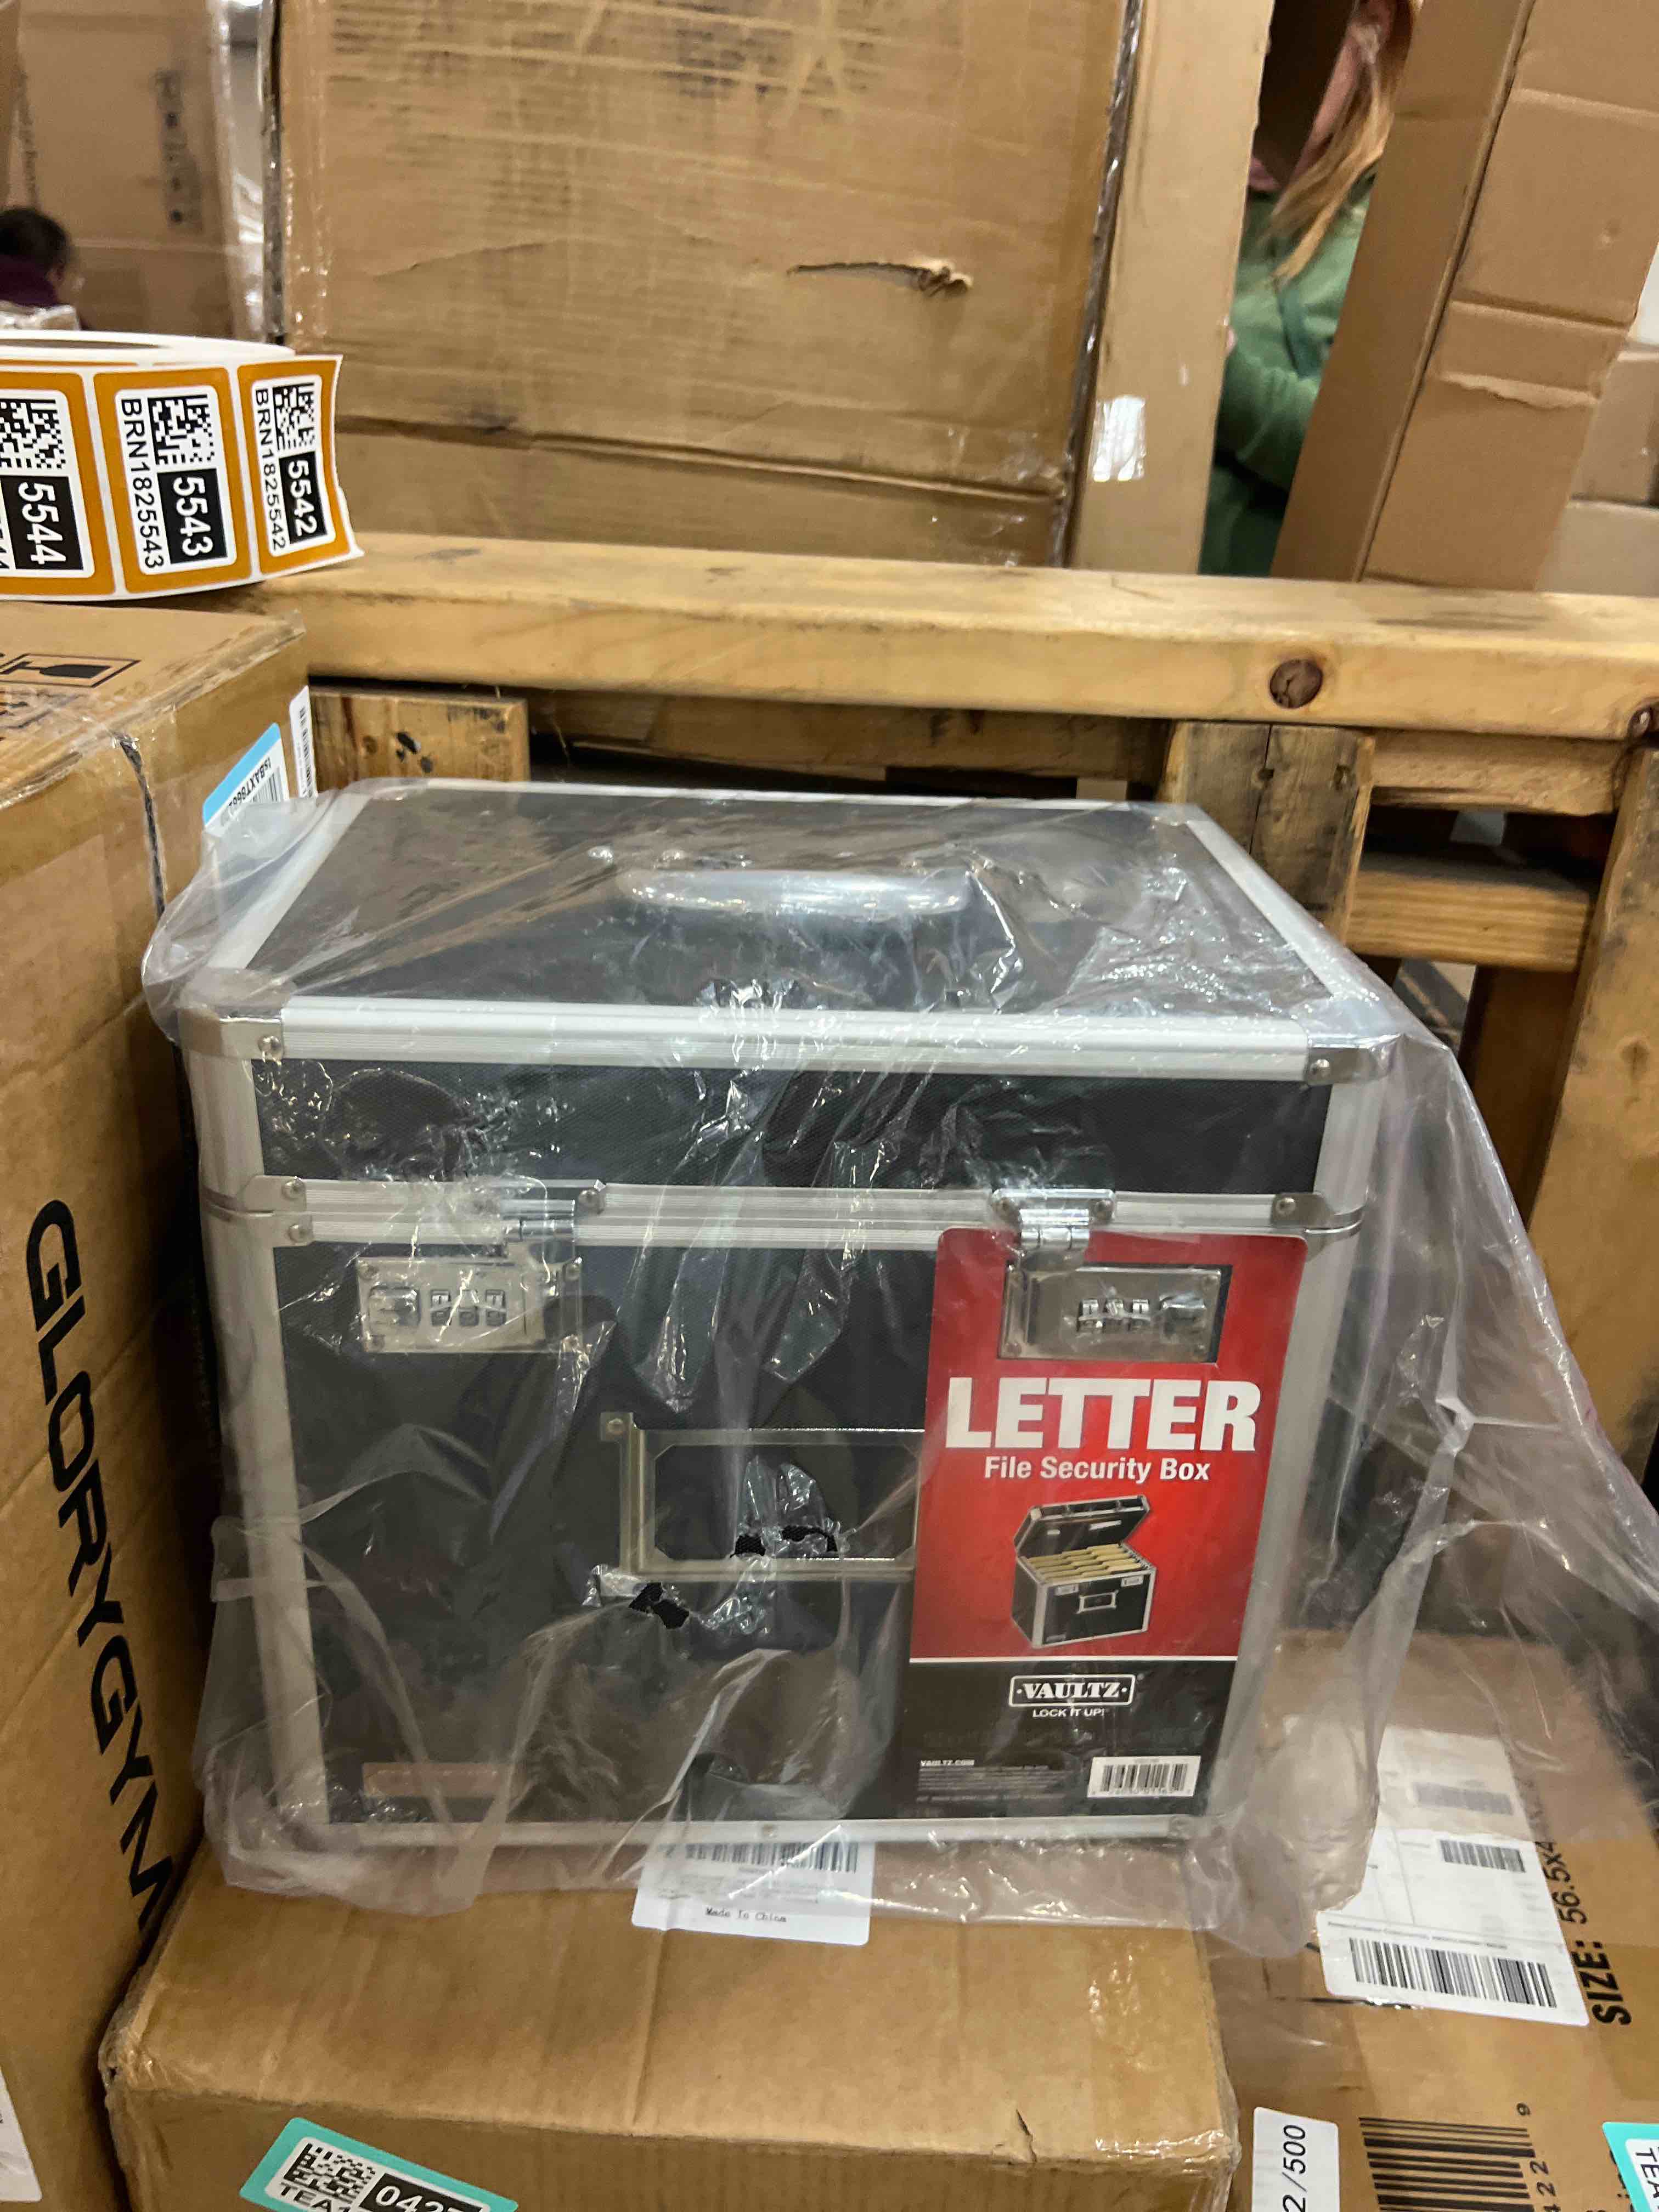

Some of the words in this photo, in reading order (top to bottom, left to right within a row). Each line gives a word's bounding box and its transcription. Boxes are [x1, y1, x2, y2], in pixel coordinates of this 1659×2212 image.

[120, 399, 165, 569] BRN1825543
[255, 389, 286, 550] BRN1825542
[287, 459, 317, 537] 5542
[18, 482, 66, 565] 5544
[172, 476, 213, 557] 5543
[945, 1376, 1261, 1452] LETTER
[984, 1456, 1031, 1480] File
[1040, 1457, 1151, 1484] Security
[1160, 1458, 1210, 1481] Box
[26, 1199, 173, 1931] GLORYGYM
[1023, 1681, 1120, 1699] VAULTZ
[1032, 1708, 1066, 1717] LOCK
[1070, 1708, 1082, 1717] IT
[1084, 1708, 1104, 1717] UP!
[705, 1907, 731, 1917] Made
[754, 1912, 787, 1922] China
[1571, 1939, 1632, 2026] SIZE:
